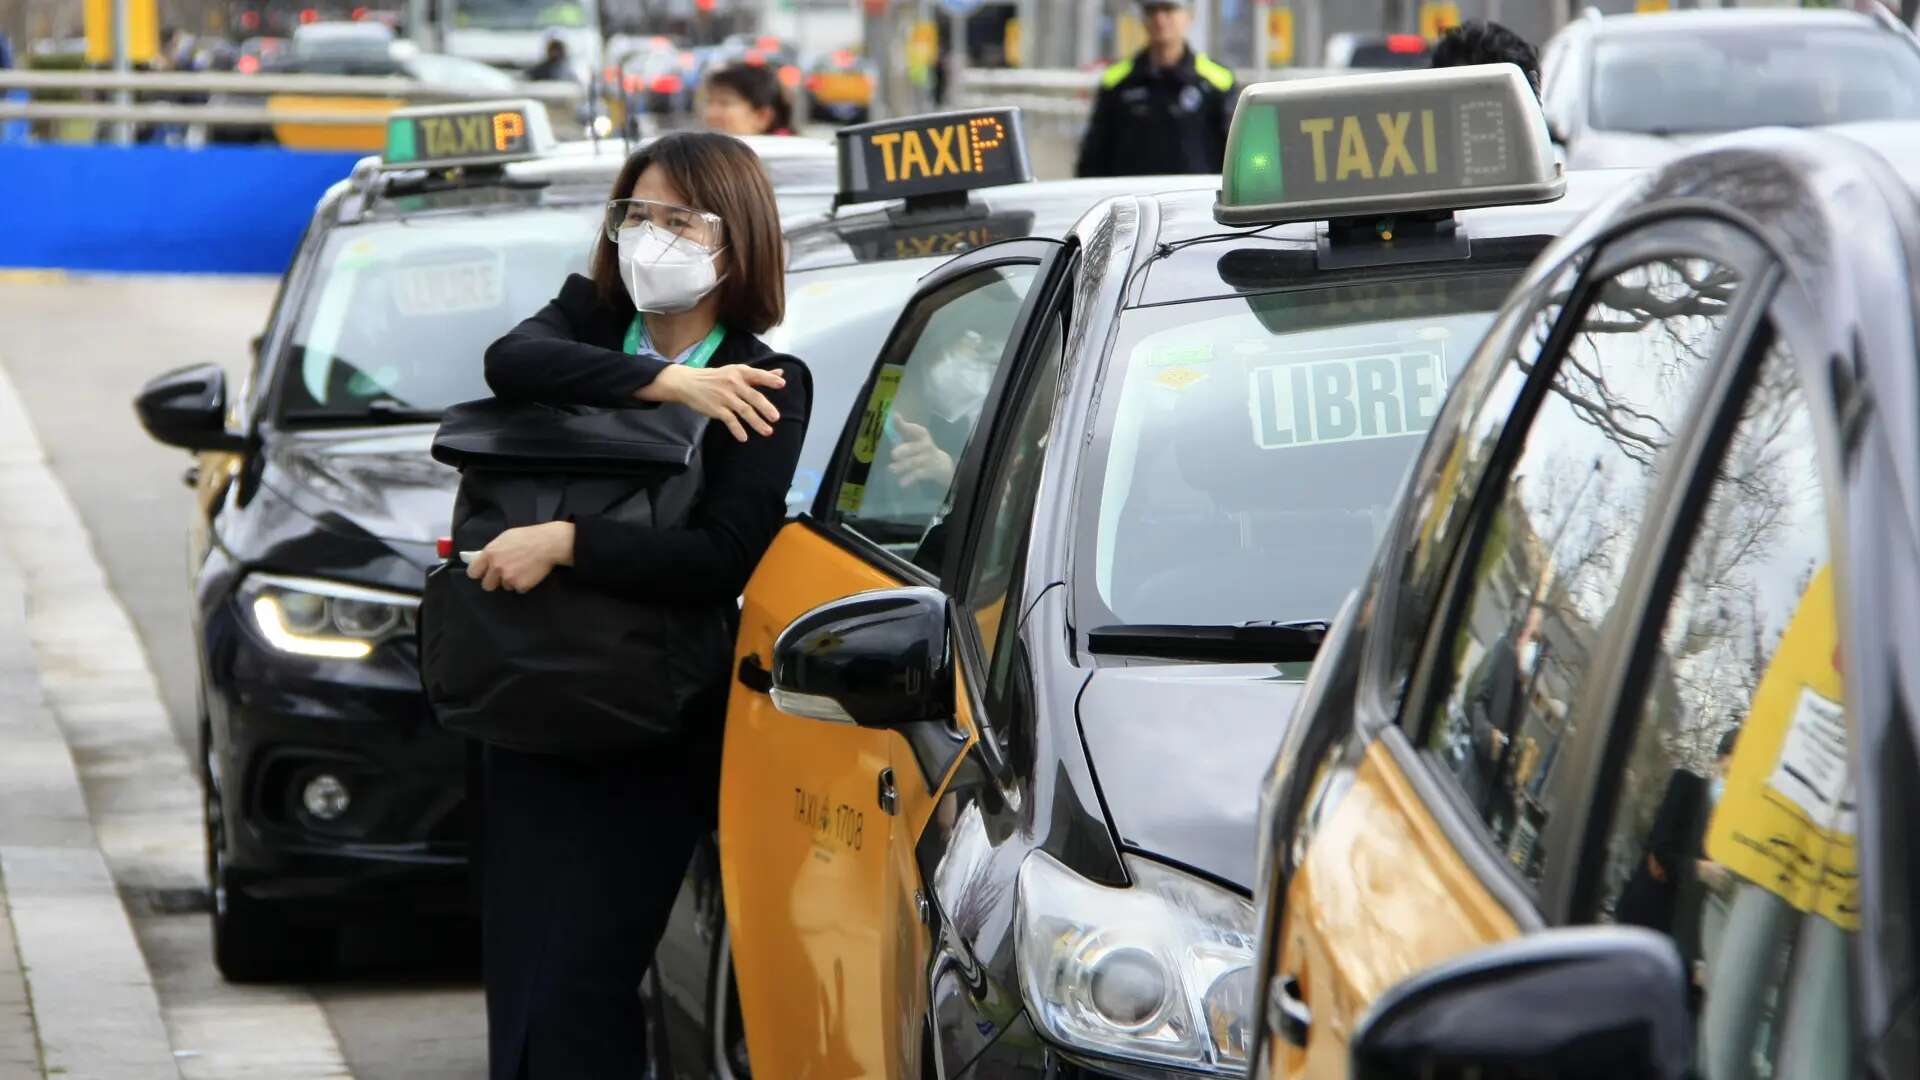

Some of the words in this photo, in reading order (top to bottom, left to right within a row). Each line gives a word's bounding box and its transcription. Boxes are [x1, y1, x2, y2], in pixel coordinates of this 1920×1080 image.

[1300, 109, 1438, 182] TAXI
[1256, 353, 1434, 446] LIBRE
[794, 786, 818, 830] TAXI
[836, 803, 864, 851] 1708
